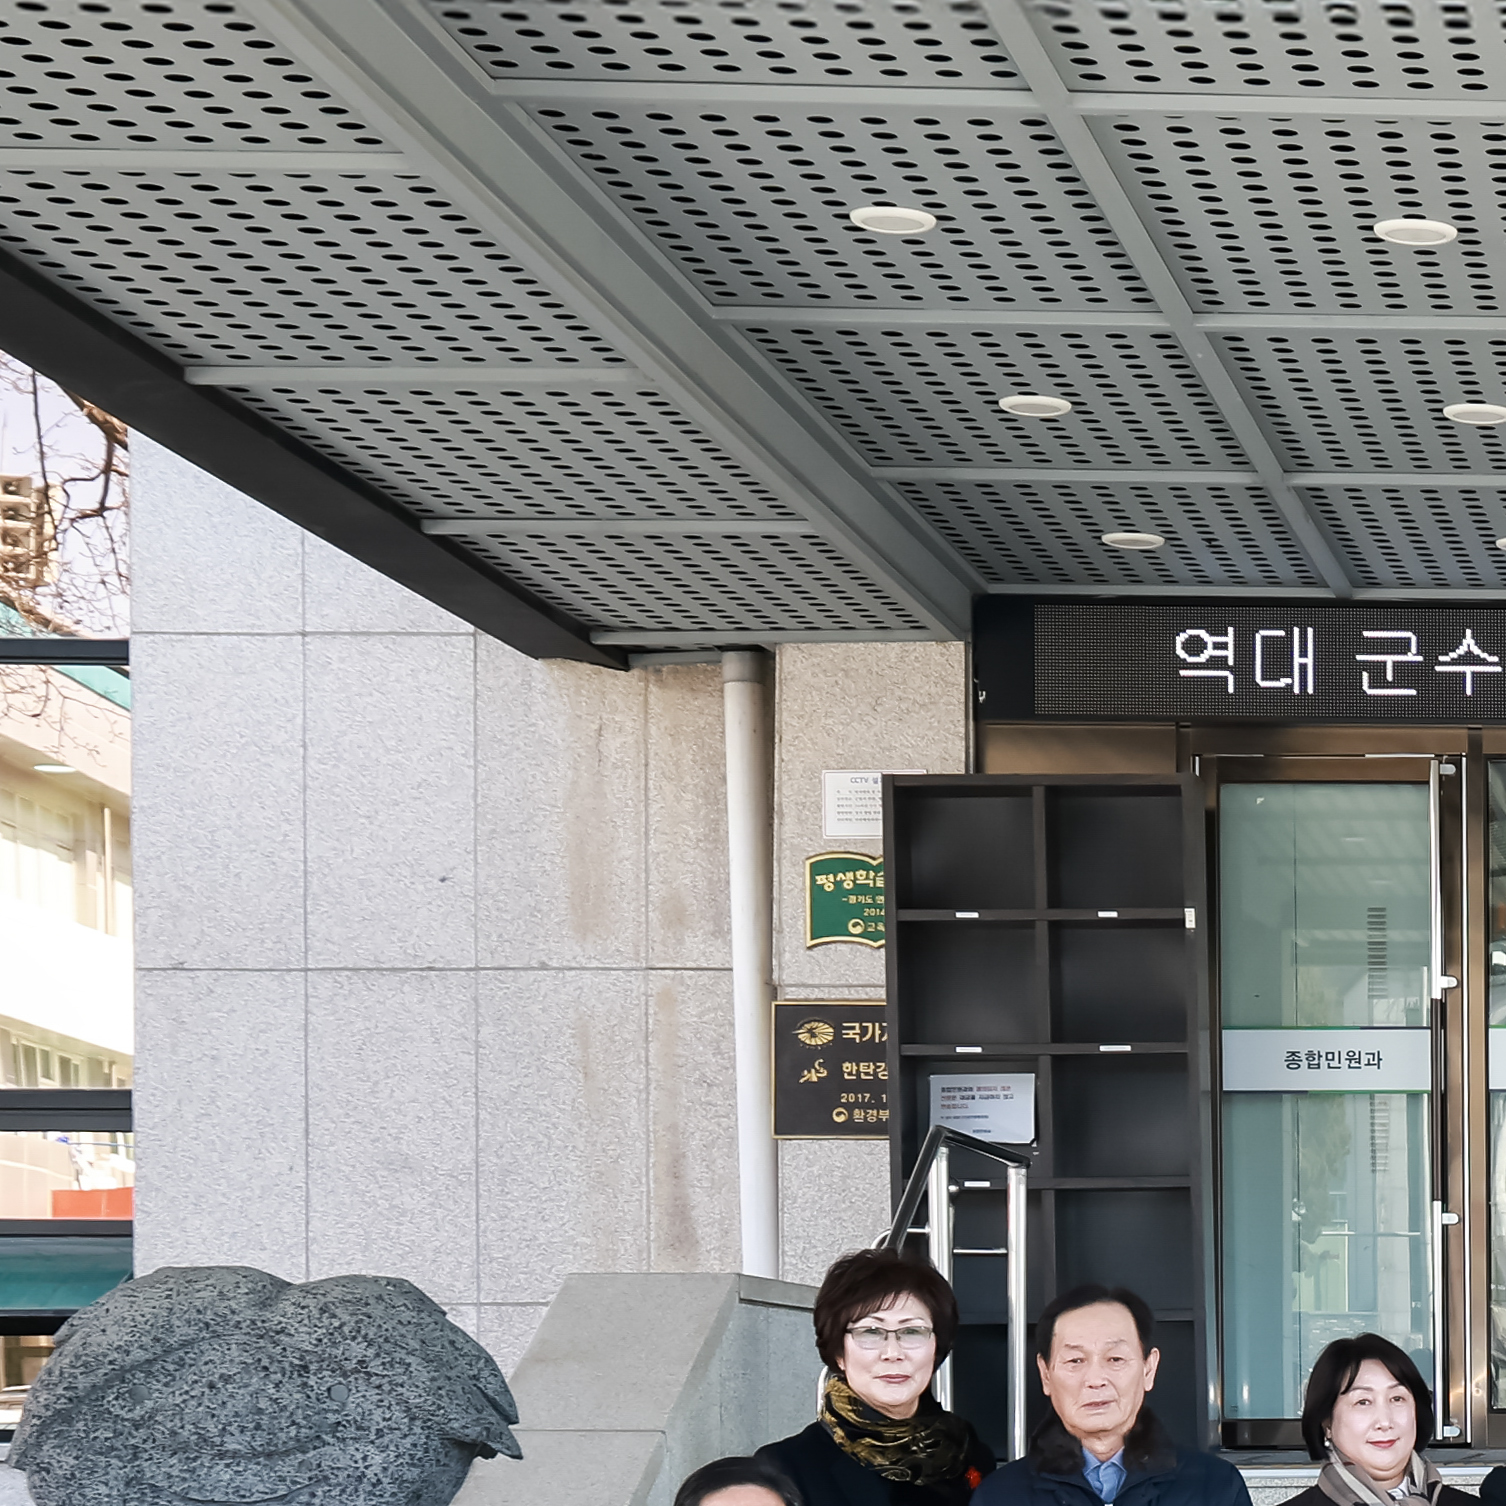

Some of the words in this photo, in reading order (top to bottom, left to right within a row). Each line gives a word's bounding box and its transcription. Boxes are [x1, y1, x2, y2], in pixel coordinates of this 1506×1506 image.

[1174, 626, 1316, 696] 역대
[1283, 1049, 1383, 1071] 종합민원과
[840, 1093, 875, 1103] 2017.
